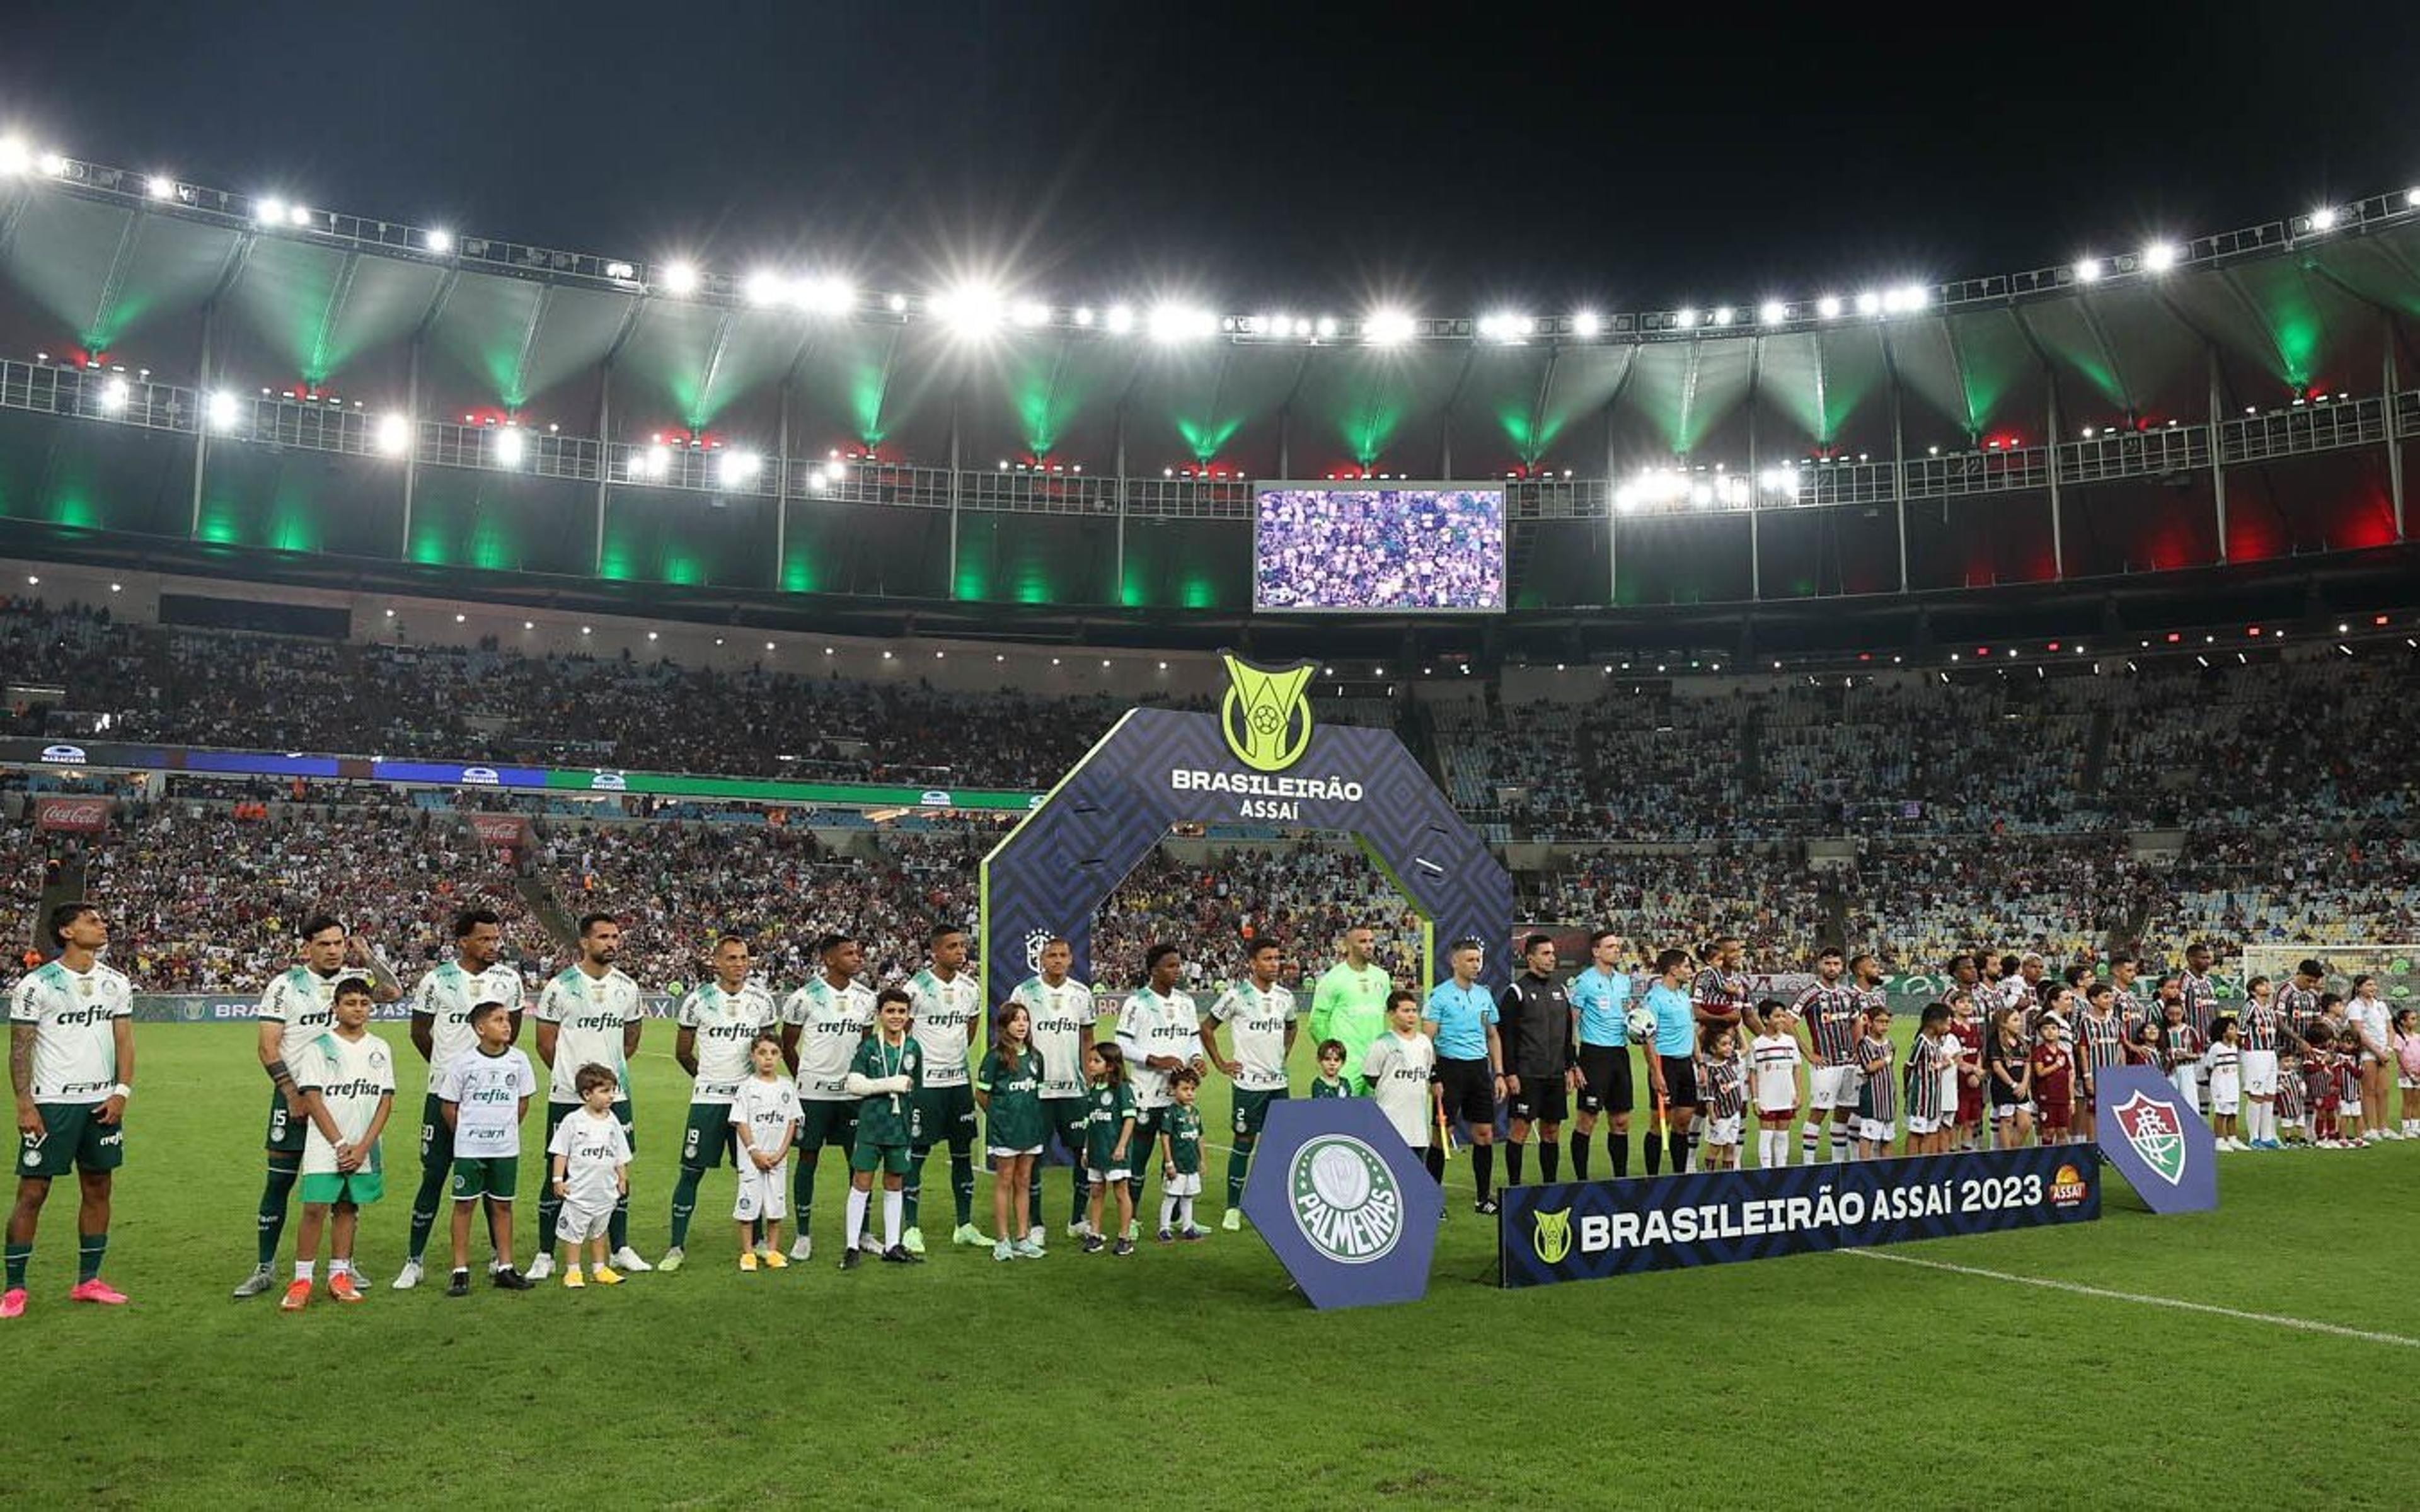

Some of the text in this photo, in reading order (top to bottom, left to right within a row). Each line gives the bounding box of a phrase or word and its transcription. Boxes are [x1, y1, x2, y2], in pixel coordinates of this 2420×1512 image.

[1172, 769, 1363, 801] BRASILEIRÃO
[1240, 799, 1299, 820] ASSAÍ
[325, 1079, 379, 1099] crefisa
[273, 1109, 286, 1126] 15
[1236, 1108, 1245, 1120] 2
[1297, 1188, 1396, 1255] PALMEIRAS
[1581, 1174, 2043, 1252] BRASILEIRÃO ASSAÍ 2023
